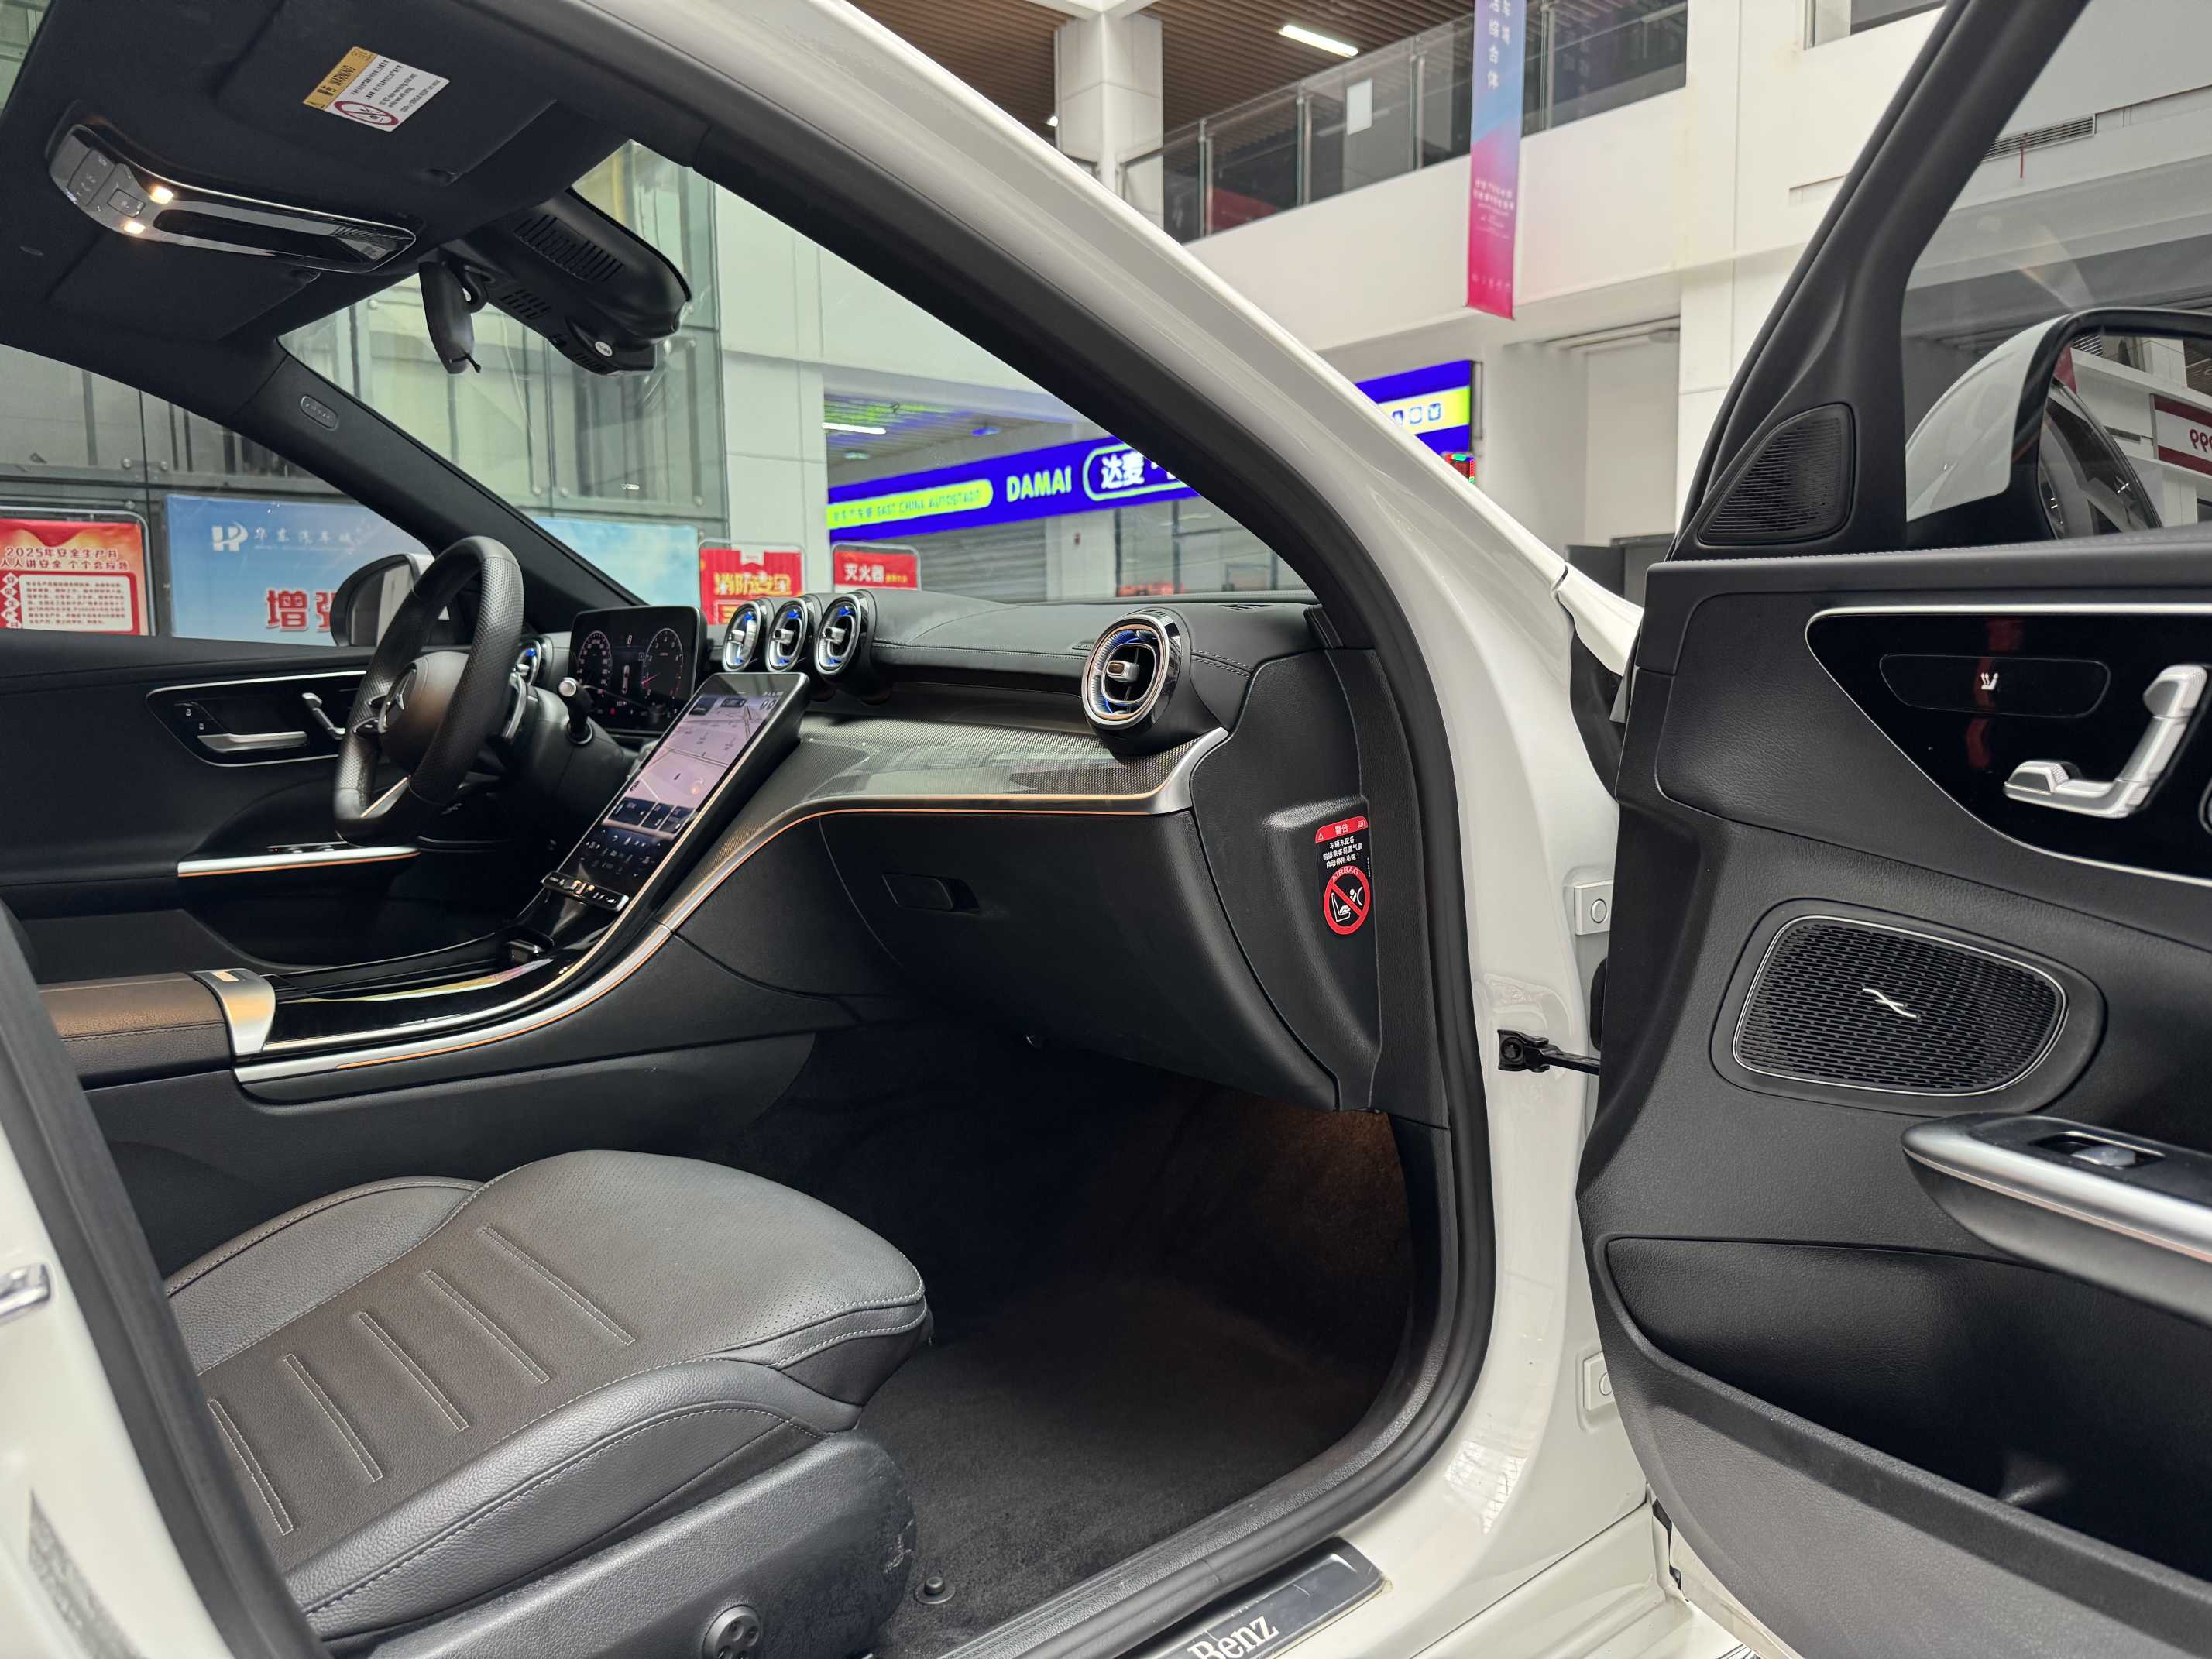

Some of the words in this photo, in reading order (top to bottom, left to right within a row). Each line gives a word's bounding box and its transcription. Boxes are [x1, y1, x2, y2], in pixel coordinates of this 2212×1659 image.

[331, 65, 356, 85] WARNING
[1007, 465, 1072, 502] DAMAI
[5, 547, 118, 558] 2025年安全生产月
[1, 559, 62, 569] 人人讲安全
[844, 563, 884, 583] 灭火器
[1334, 823, 1348, 835] 警告
[1331, 867, 1358, 882] AIRBAG
[1187, 1616, 1279, 1659] Benz
